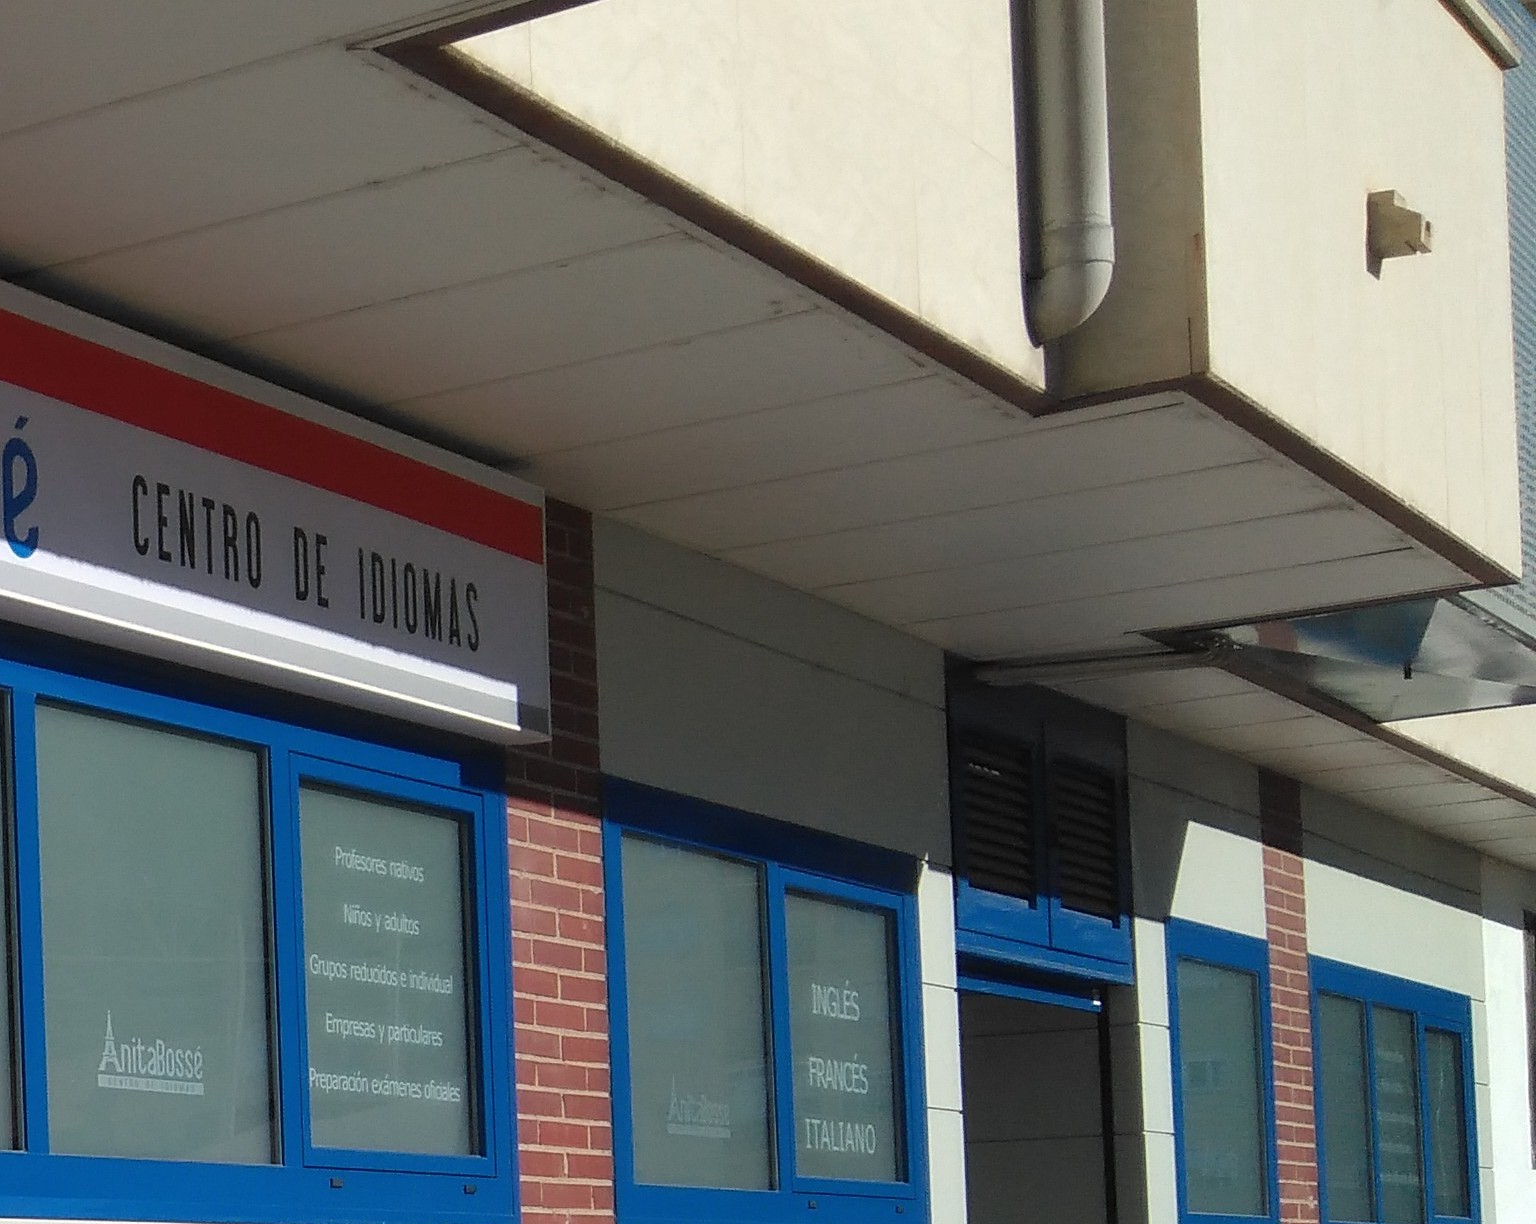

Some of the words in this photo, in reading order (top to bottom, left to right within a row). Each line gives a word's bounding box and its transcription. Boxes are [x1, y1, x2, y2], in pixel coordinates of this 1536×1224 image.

[131, 473, 262, 590] CENTRO
[293, 525, 329, 608] DE
[358, 546, 481, 653] IDIOMAS
[334, 846, 388, 876] Profesores
[389, 859, 425, 883] nativos
[343, 903, 373, 928] Niños
[374, 913, 382, 933] y
[383, 911, 421, 936] adultos
[309, 953, 348, 981] Grupos
[349, 961, 399, 987] reducidos
[399, 971, 407, 988] e
[408, 969, 454, 995] individual
[811, 979, 861, 1022] INGLÉS
[325, 1011, 376, 1040] Empresas
[377, 1023, 385, 1045] y
[387, 1023, 444, 1047] particulares
[308, 1067, 369, 1094] Preparación
[371, 1073, 423, 1099] exámenes
[424, 1079, 462, 1103] oficiales
[808, 1052, 870, 1095] FRANCÉS
[805, 1118, 877, 1155] ITALIANO
